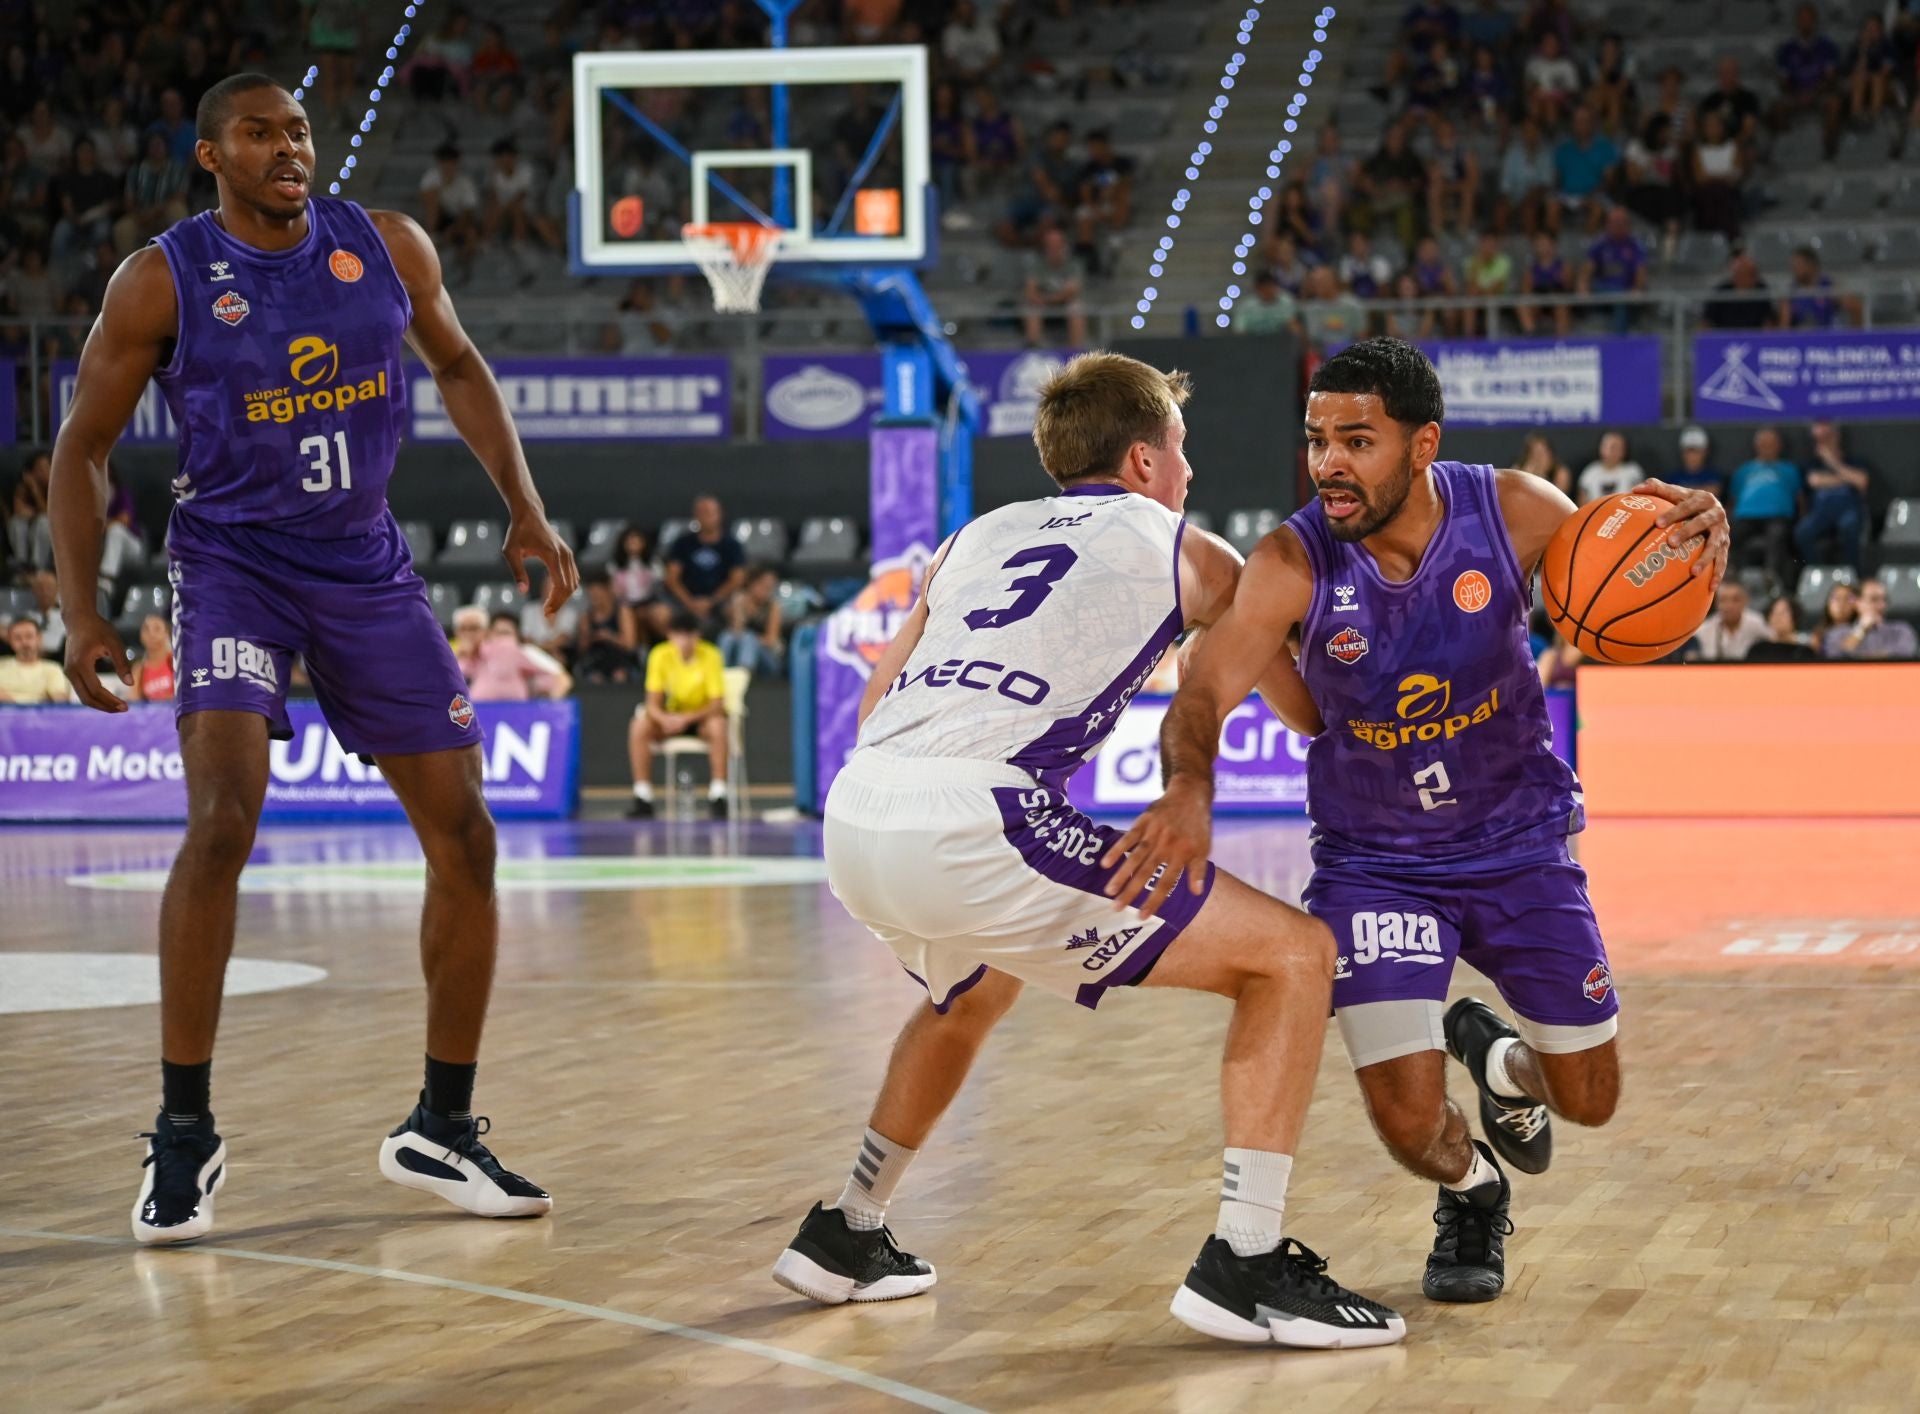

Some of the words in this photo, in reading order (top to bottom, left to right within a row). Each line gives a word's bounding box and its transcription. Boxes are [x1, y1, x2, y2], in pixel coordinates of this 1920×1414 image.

[214, 303, 247, 316] PALENCIA
[246, 371, 387, 423] agropal
[300, 431, 351, 492] 31
[962, 543, 1079, 632] 3
[1333, 602, 1359, 612] hummel
[212, 637, 278, 685] gaza
[1329, 641, 1367, 653] PALENCIA
[1218, 703, 1308, 762] Gru
[1353, 688, 1499, 751] agropal
[86, 744, 186, 782] Moto
[1413, 760, 1458, 812] 2
[1082, 926, 1144, 971] CRZA
[1351, 911, 1442, 965] gaza
